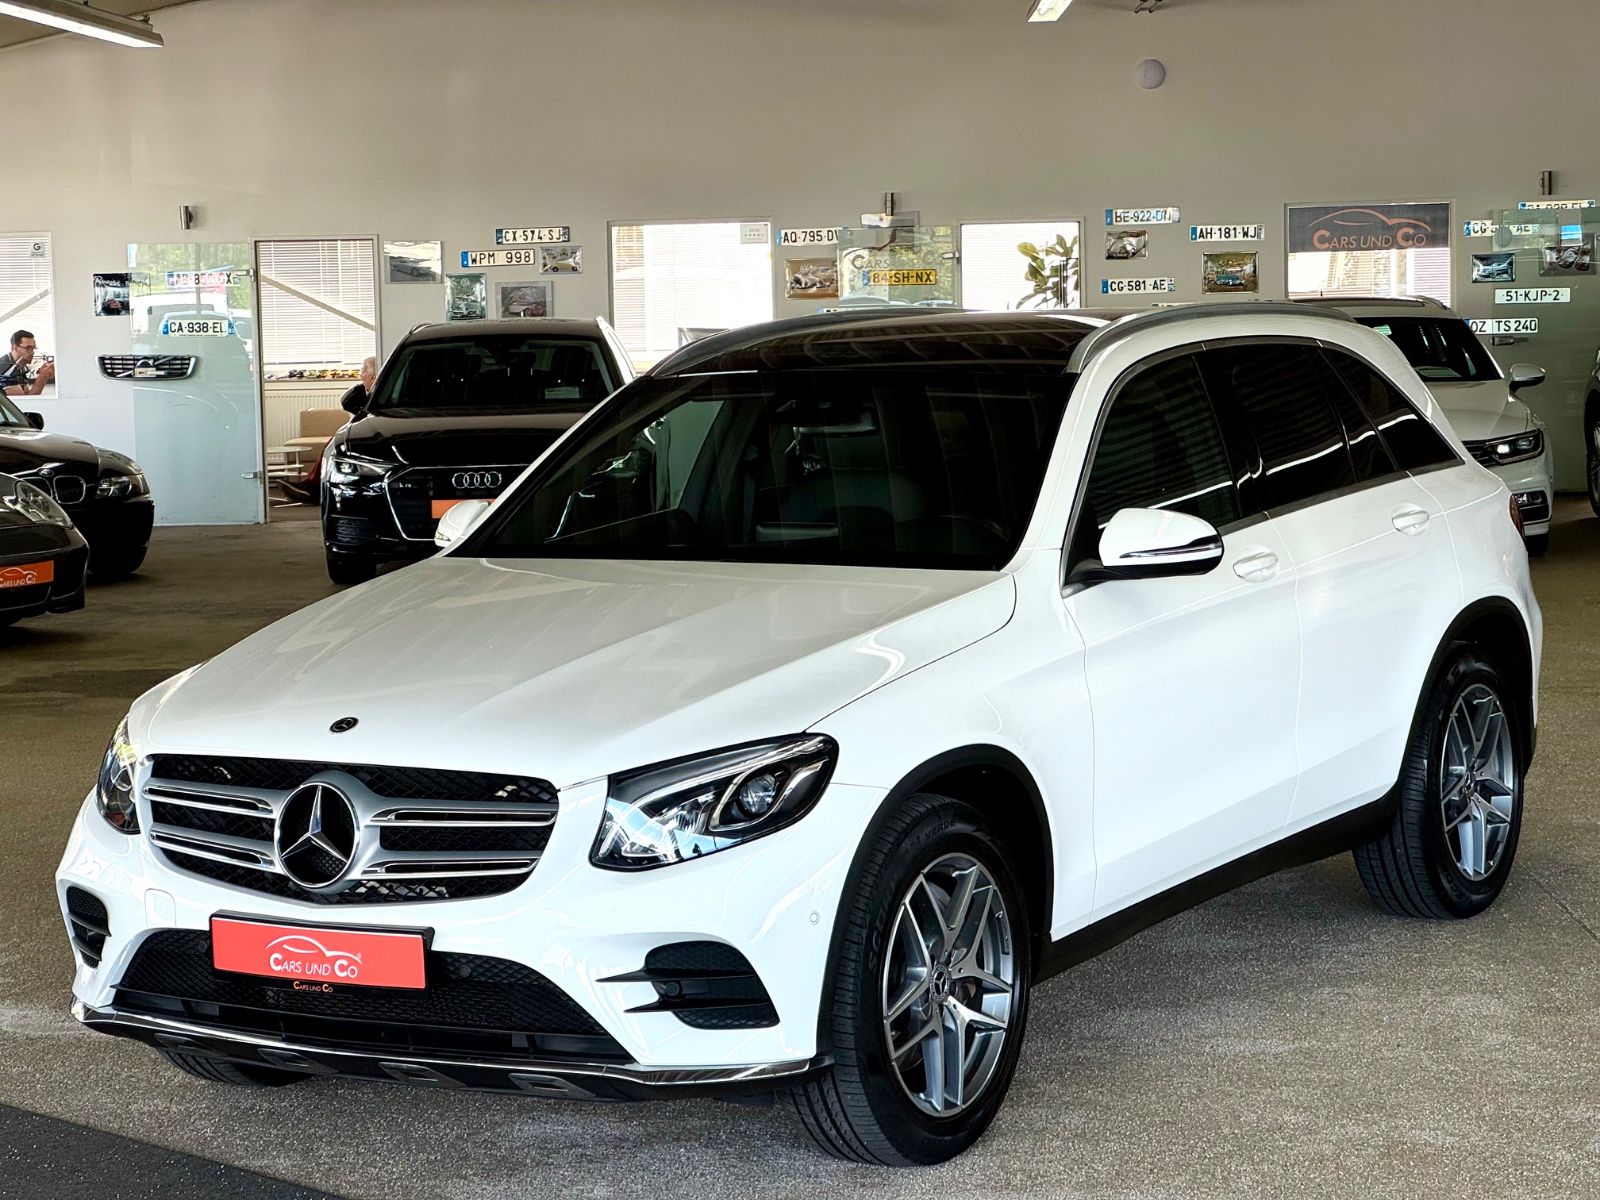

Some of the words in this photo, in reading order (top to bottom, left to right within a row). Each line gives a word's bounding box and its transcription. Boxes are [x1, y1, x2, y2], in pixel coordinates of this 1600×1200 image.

[503, 227, 562, 242] CX-574-SJ
[1197, 226, 1257, 240] AH-181-WJ
[1312, 229, 1357, 250] CARS
[1360, 235, 1393, 248] UND
[1396, 226, 1427, 247] CO
[469, 253, 496, 266] WPM
[505, 251, 532, 264] 998
[872, 271, 932, 284] 84-SH-NX
[1109, 280, 1167, 292] CG-581-AE
[1505, 289, 1561, 302] 51-KJP-2
[1495, 320, 1512, 332] TS
[1514, 319, 1538, 332] 240
[269, 953, 302, 973] CARS
[305, 963, 331, 977] UND
[334, 959, 358, 978] CO
[293, 981, 309, 991] CARS
[322, 983, 333, 993] CO
